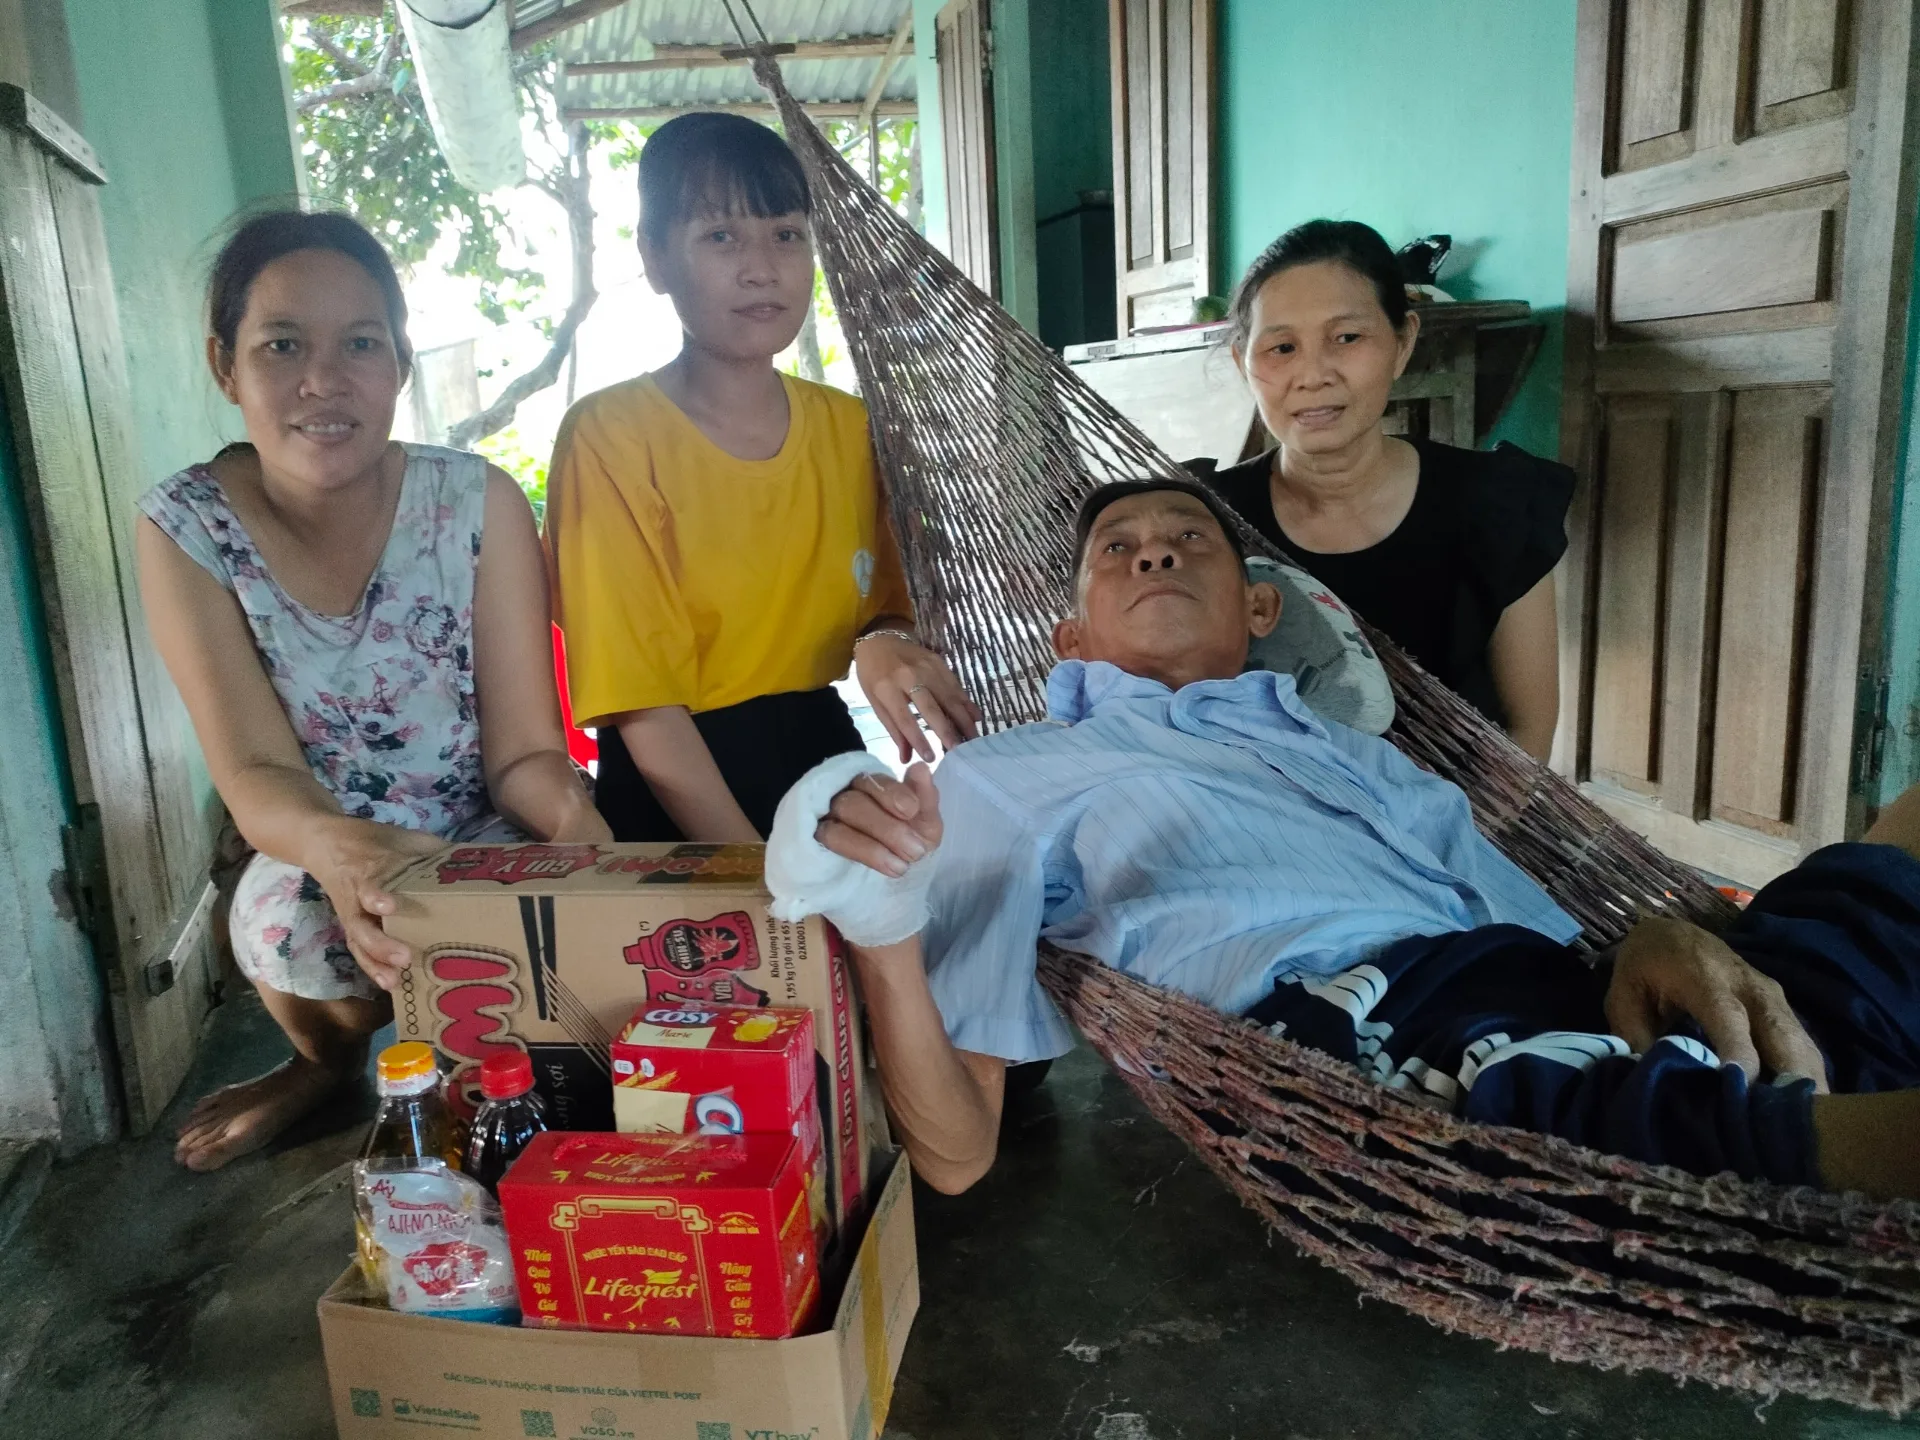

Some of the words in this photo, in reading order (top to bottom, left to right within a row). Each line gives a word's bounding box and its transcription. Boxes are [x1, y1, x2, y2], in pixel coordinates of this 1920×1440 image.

[781, 925, 790, 935] 65
[796, 918, 807, 960] 02KK0031
[672, 930, 692, 970] CHIN-SU
[783, 956, 795, 970] (30
[784, 971, 796, 981] kg
[831, 955, 845, 1005] cay
[785, 982, 797, 1000] 1,95
[644, 1009, 719, 1024] COSY
[834, 1010, 853, 1082] chua
[584, 1276, 699, 1301] Lifesnest
[631, 1390, 670, 1399] VIETTEL
[674, 1391, 701, 1400] POST
